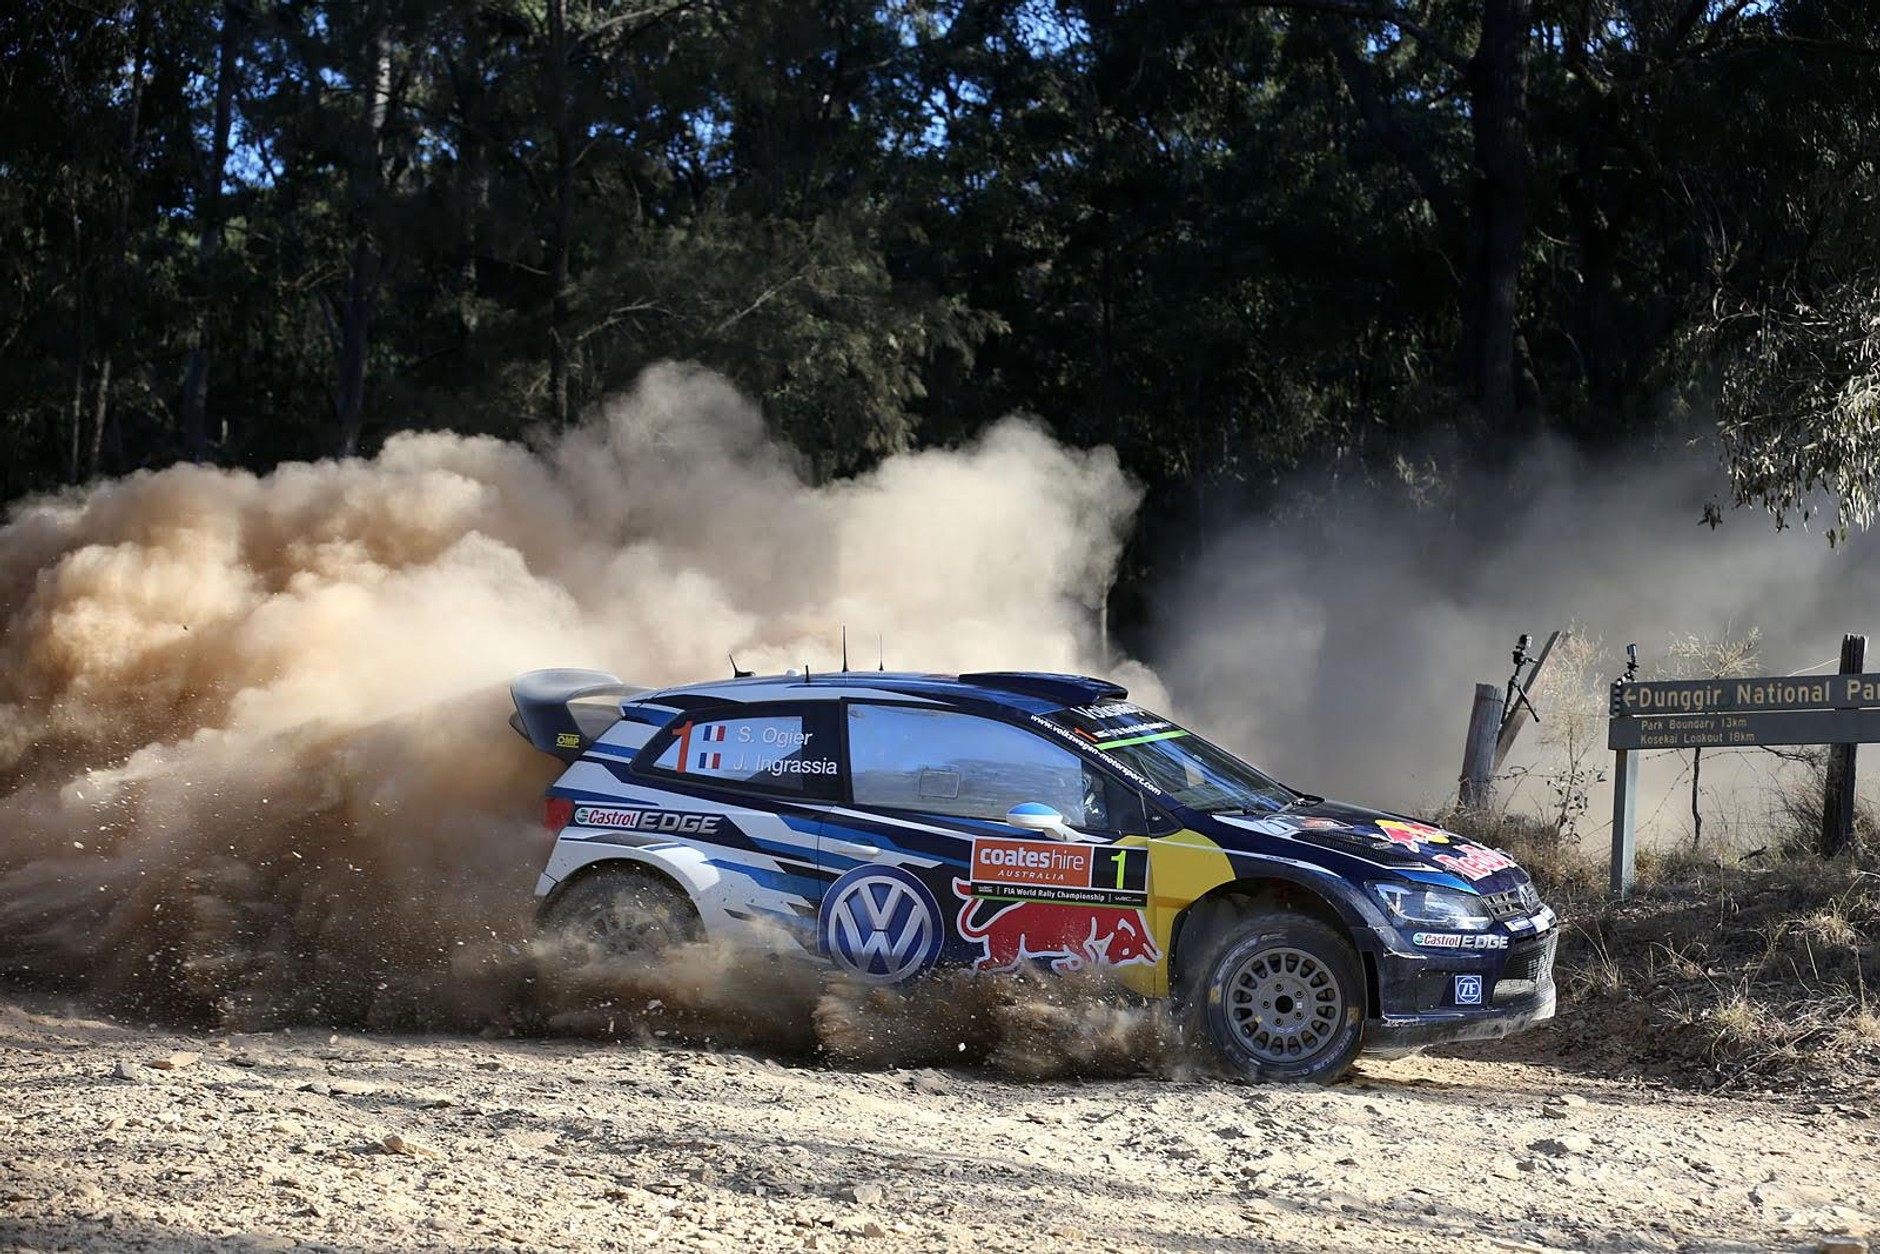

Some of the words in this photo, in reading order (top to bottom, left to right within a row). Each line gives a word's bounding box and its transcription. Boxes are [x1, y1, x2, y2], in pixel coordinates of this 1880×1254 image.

[1639, 684, 1722, 711] Dunggir
[1736, 681, 1830, 704] National
[1641, 720, 1663, 731] Park
[1669, 719, 1715, 730] Boundary
[1721, 718, 1747, 728] 13km
[556, 735, 580, 747] OMP
[737, 726, 755, 743] S.
[762, 727, 813, 748] Ogier
[1640, 734, 1678, 744] Kosekai
[1683, 732, 1723, 744] Lookout
[1729, 731, 1755, 742] 18km
[672, 720, 694, 773] 1
[1030, 714, 1161, 796] www.volkswagen-motorsport.com
[733, 754, 748, 770] J.
[755, 753, 838, 777] Ingrassia
[588, 809, 636, 826] Castrol
[638, 811, 724, 835] EDGE
[997, 869, 1065, 881] AUSTRALIA
[1110, 850, 1127, 890] 1
[1003, 887, 1016, 895] FIA
[1016, 888, 1037, 897] World
[1038, 889, 1056, 899] Rally
[1057, 891, 1105, 902] Championship
[1424, 935, 1459, 947] Castrol
[1460, 934, 1509, 949] EDGE
[1460, 982, 1477, 996] ZF
